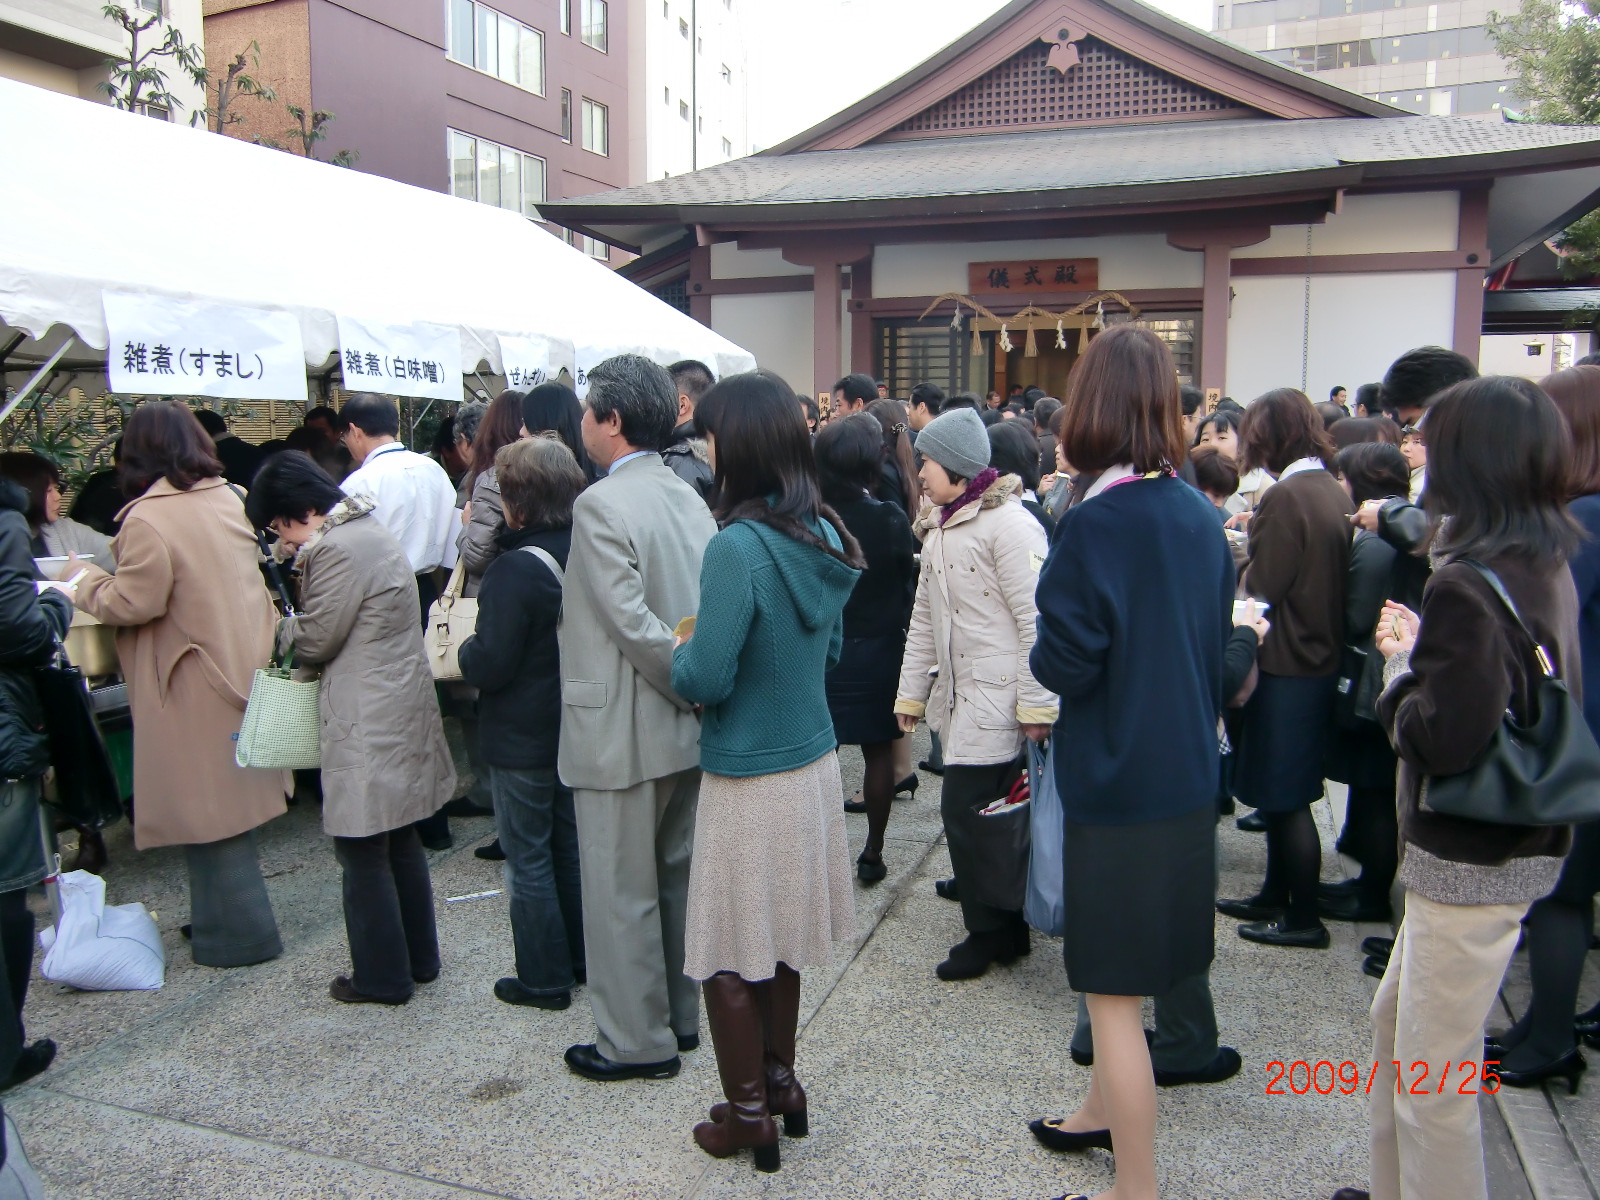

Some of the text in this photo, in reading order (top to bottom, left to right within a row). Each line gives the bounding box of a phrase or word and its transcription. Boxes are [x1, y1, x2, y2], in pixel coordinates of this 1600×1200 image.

[987, 265, 1079, 289] 儀式殿
[123, 340, 264, 380] 雑煮(すまし)
[509, 366, 546, 386] ぜんざい
